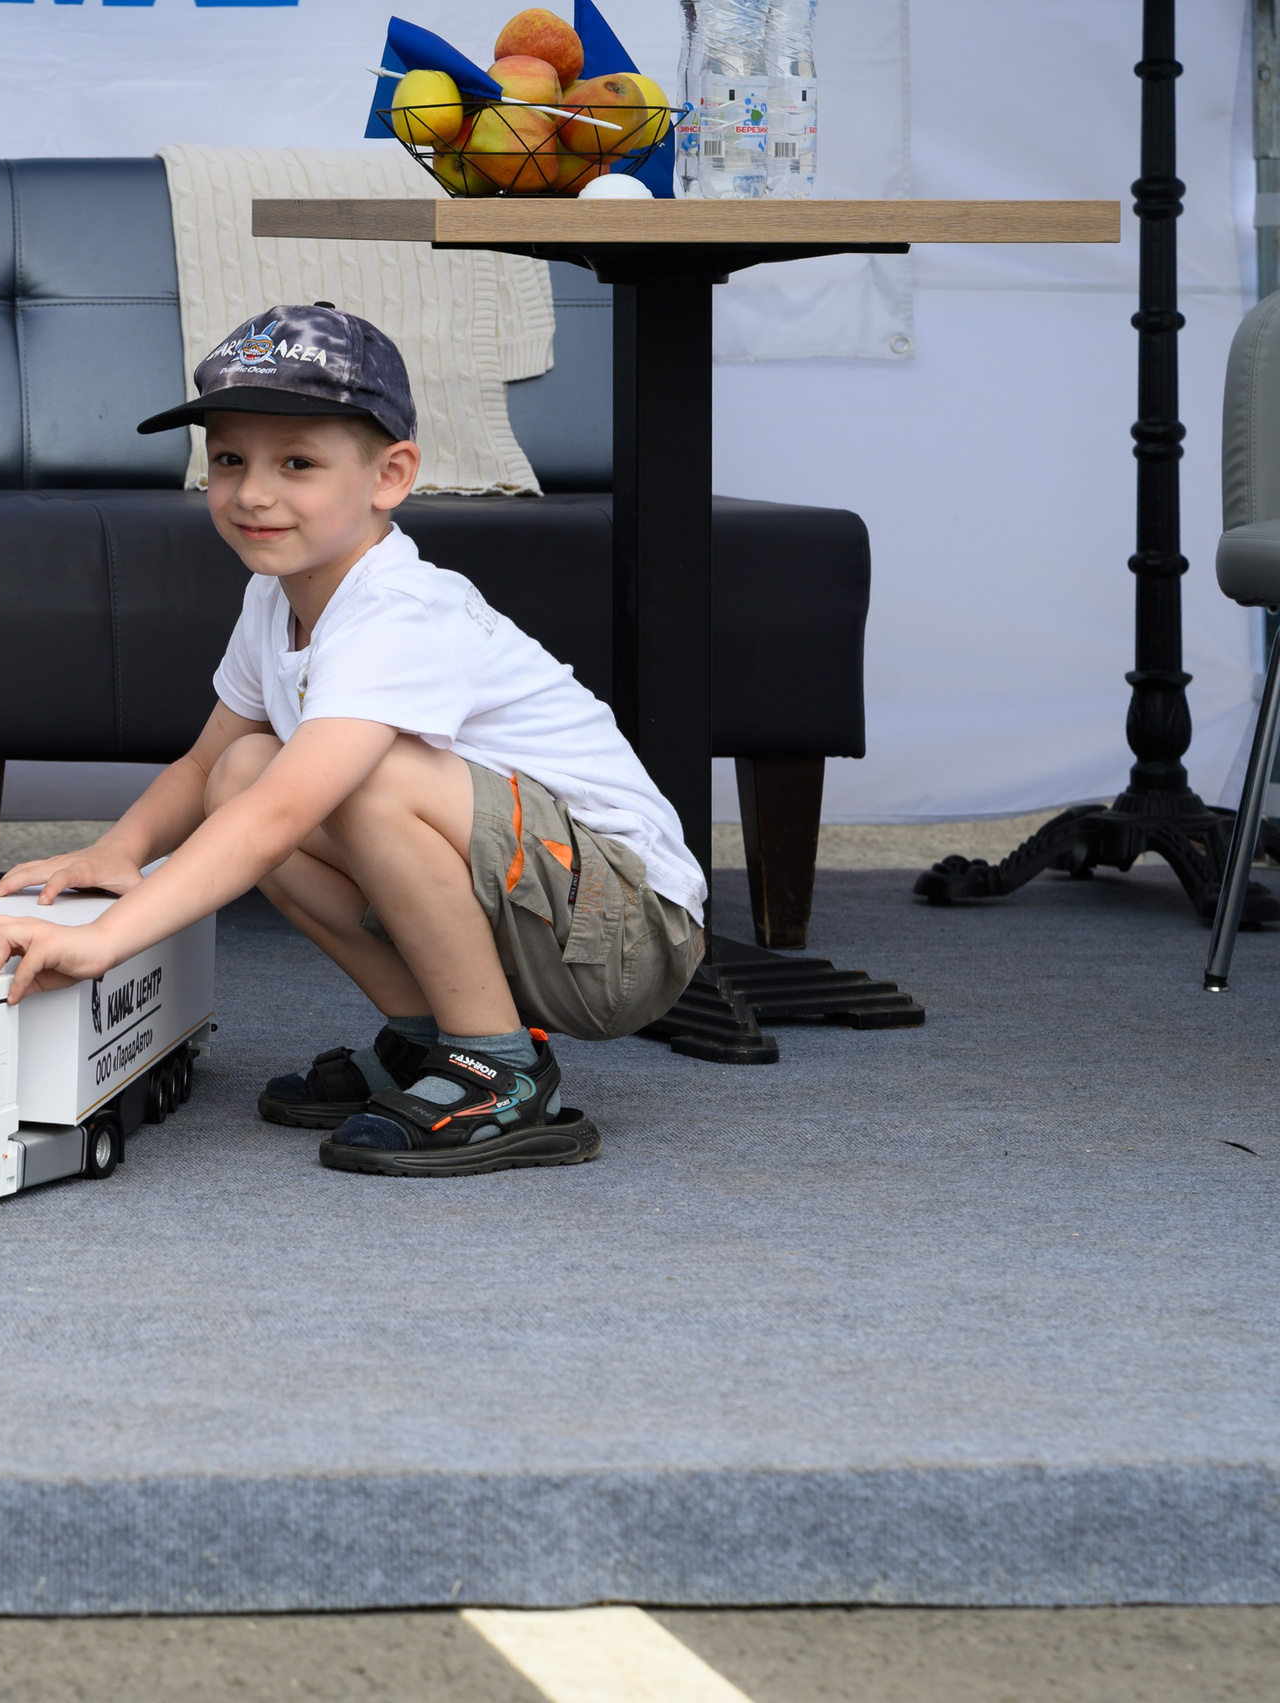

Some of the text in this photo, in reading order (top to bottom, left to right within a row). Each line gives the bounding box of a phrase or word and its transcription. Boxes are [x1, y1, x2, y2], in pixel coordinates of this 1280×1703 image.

[274, 340, 327, 367] AREA
[107, 966, 162, 1031] KAMAZ ЦЕНТР
[96, 1052, 112, 1086] ООО
